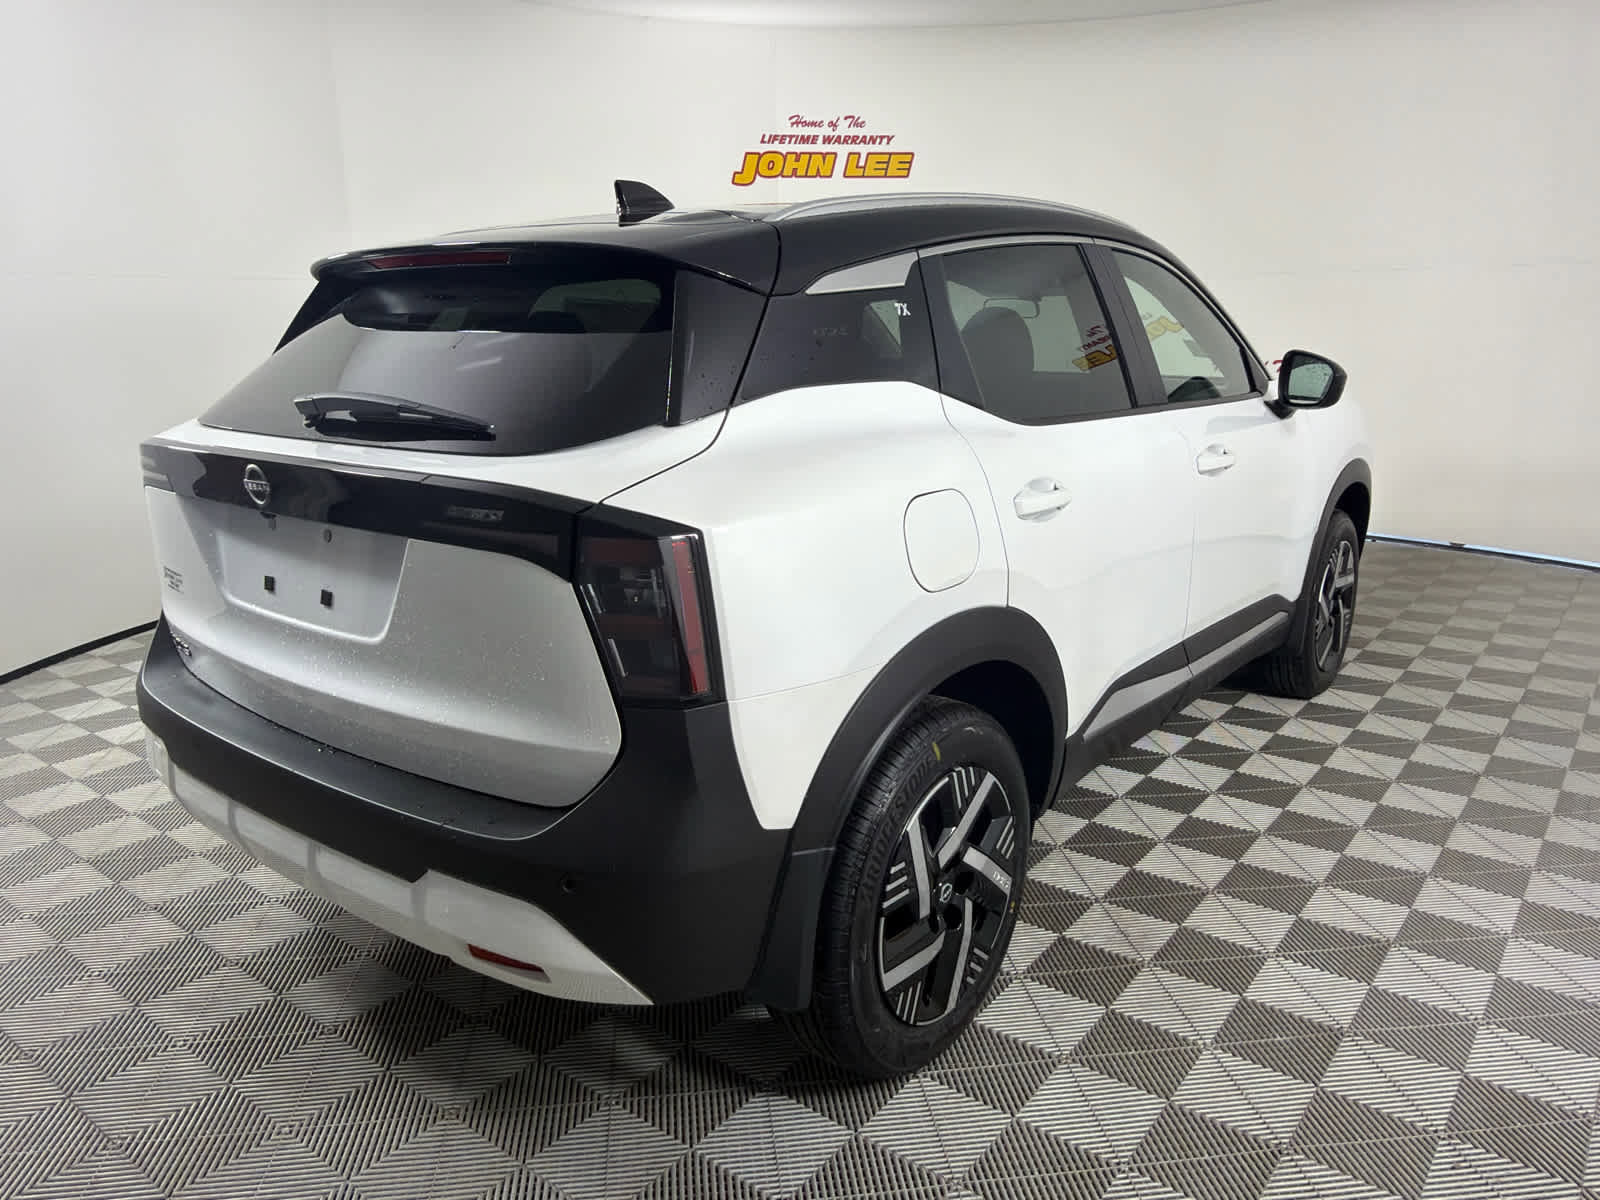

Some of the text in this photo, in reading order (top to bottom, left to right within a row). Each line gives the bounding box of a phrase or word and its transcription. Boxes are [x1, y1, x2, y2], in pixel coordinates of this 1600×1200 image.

[788, 114, 866, 132] Home of The
[760, 133, 895, 146] LIFETIME WARRANTY
[732, 150, 915, 186] JOHN LEE
[894, 301, 911, 317] TX
